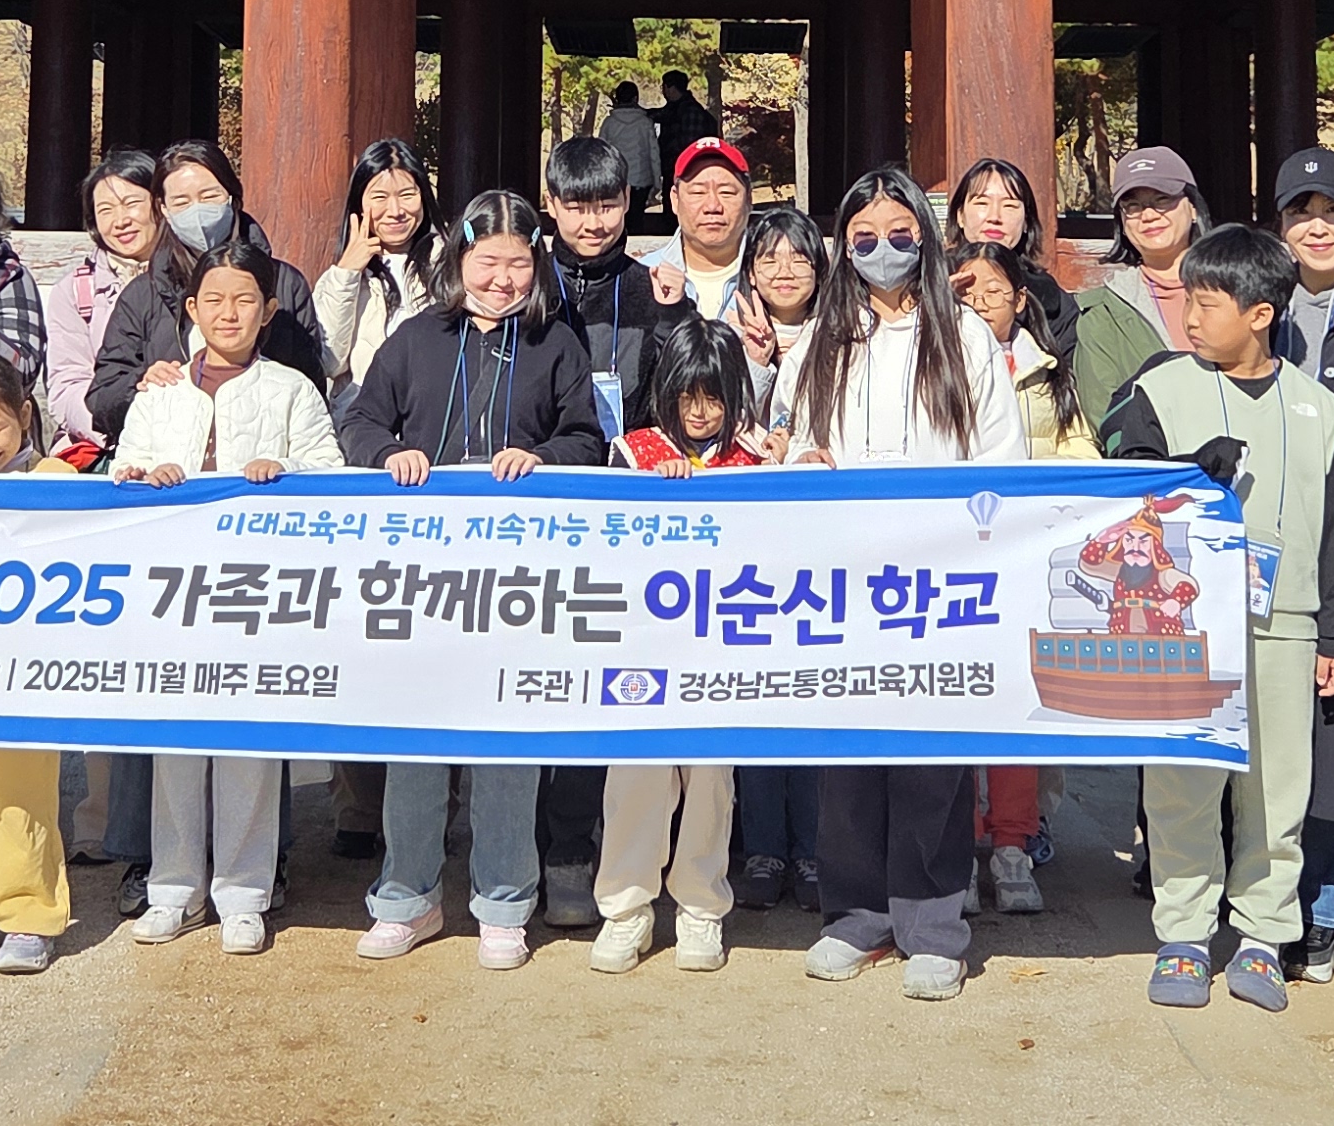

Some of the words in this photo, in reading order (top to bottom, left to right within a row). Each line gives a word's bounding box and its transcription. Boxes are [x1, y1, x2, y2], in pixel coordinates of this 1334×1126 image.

[216, 511, 368, 545] 미래교육의
[379, 513, 452, 546] 등대,
[465, 513, 590, 548] 지속가능
[601, 513, 722, 548] 통영교육
[148, 563, 342, 636] 가족과
[358, 560, 628, 643] 함께하는
[645, 564, 846, 646] 이순신
[867, 565, 999, 639] 학교
[23, 660, 127, 693] 2025년
[135, 662, 186, 694] 11월
[193, 662, 248, 696] 매주
[255, 664, 338, 698] 토요일
[515, 670, 574, 703] 주관
[679, 662, 994, 703] 경상남도통영교육지원청
